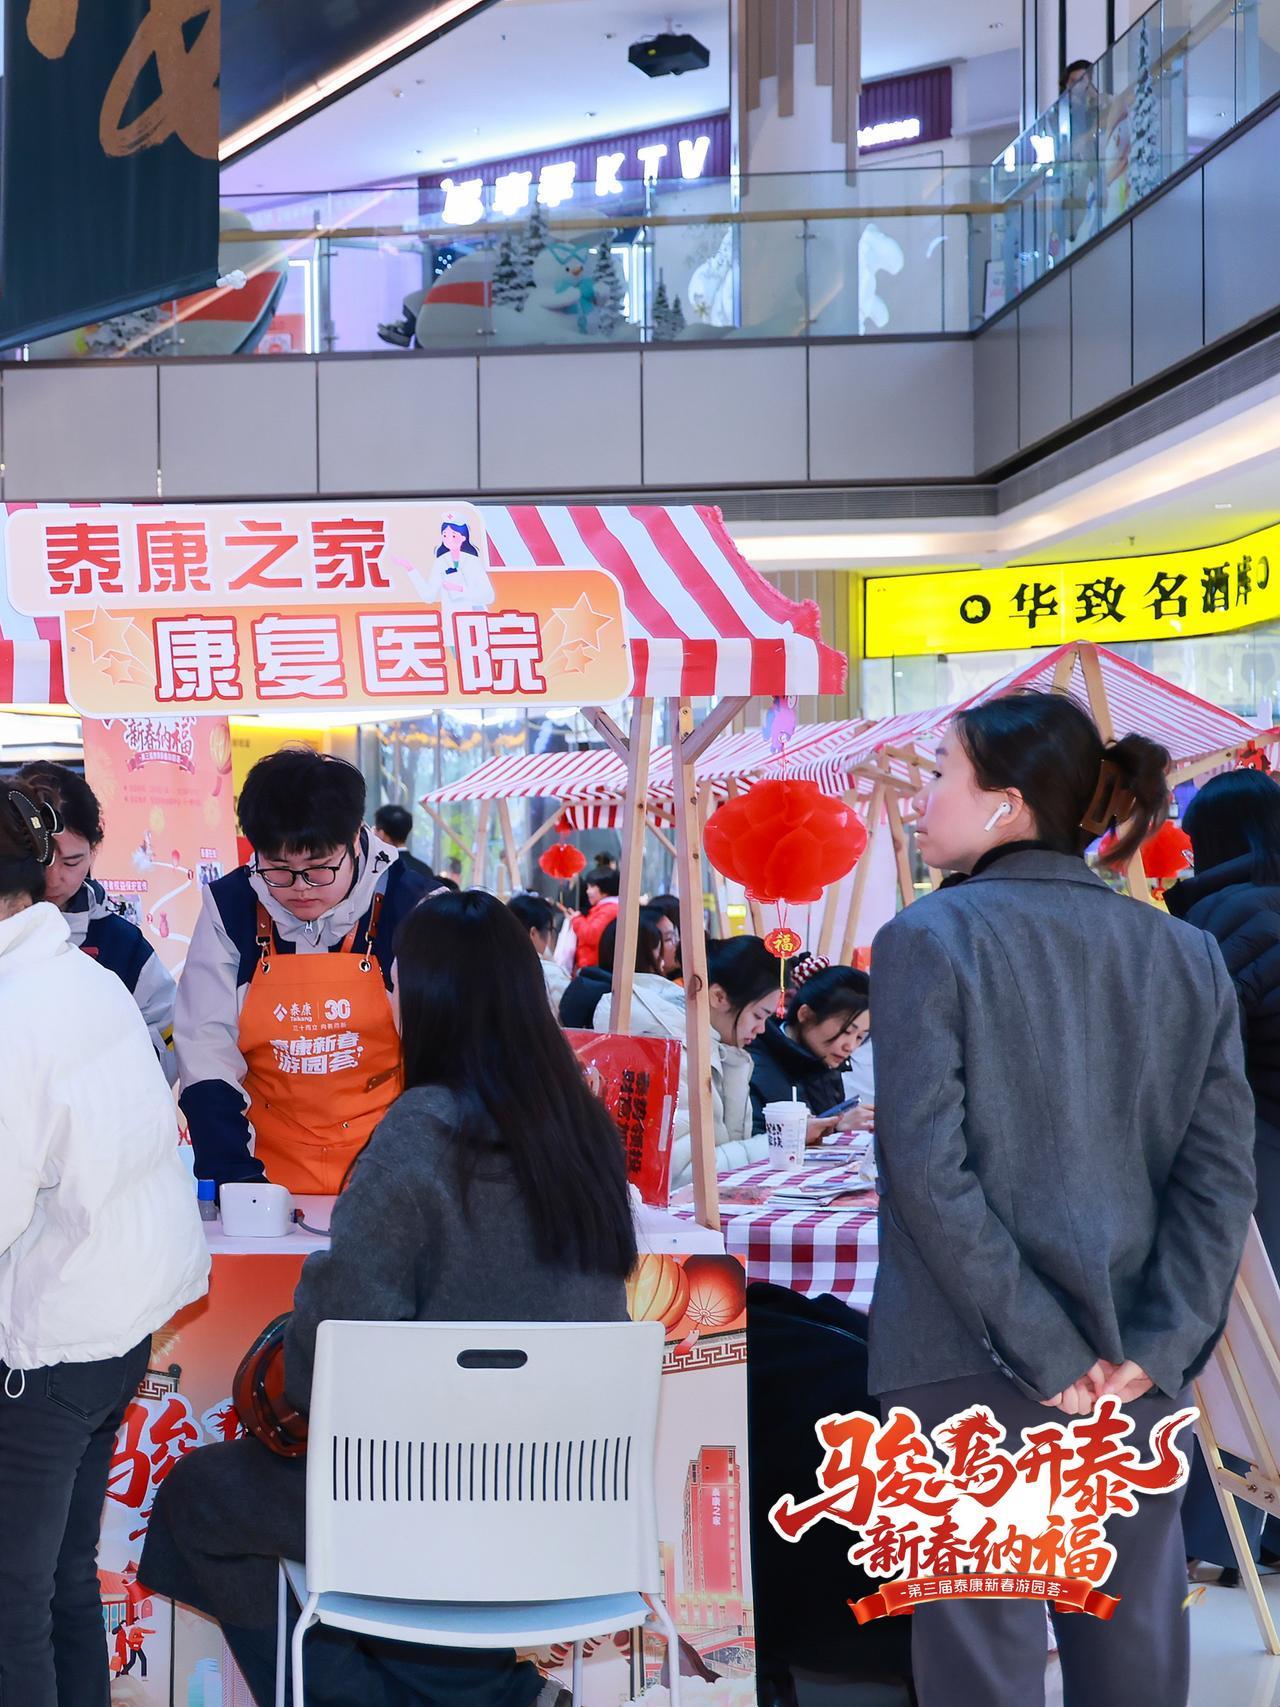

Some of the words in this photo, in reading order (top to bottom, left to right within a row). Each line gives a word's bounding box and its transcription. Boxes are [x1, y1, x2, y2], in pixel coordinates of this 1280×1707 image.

[45, 519, 391, 596] 泰康之家
[1008, 554, 1253, 630] 华致名酒库
[154, 612, 546, 701] 康复医院
[772, 931, 794, 953] 福
[324, 998, 352, 1021] 30
